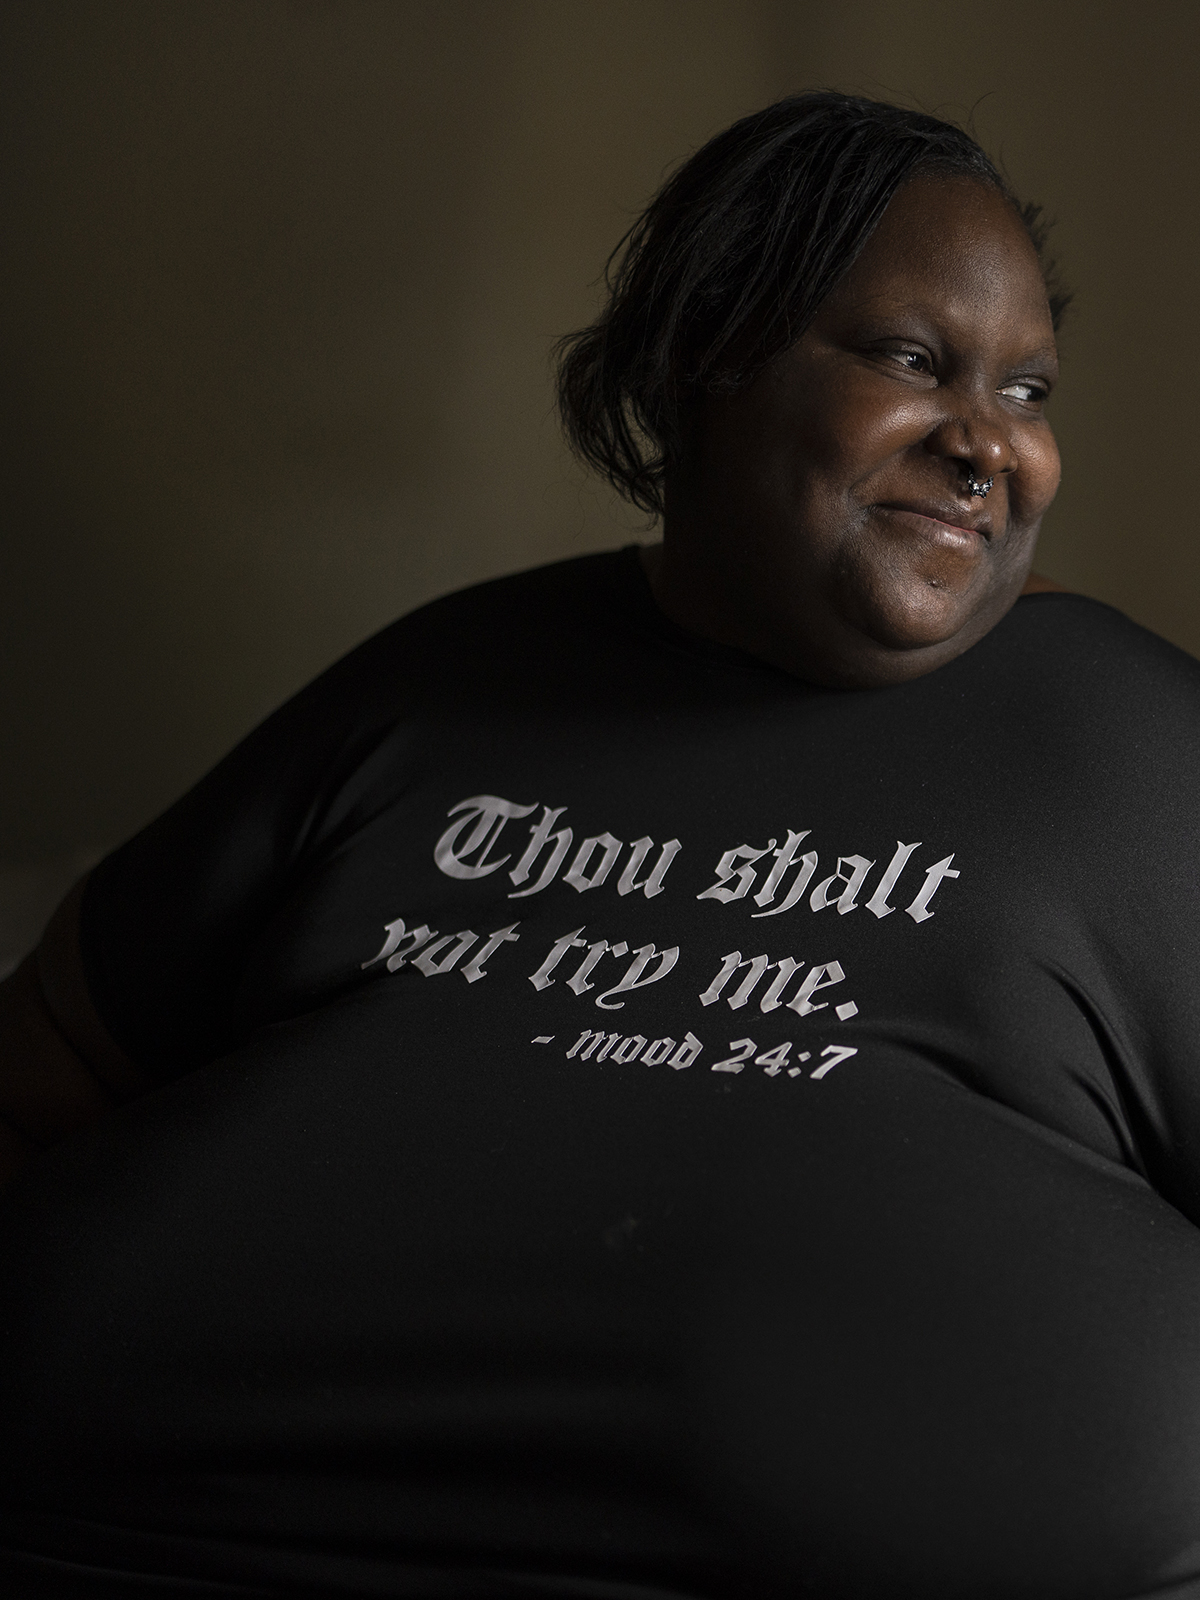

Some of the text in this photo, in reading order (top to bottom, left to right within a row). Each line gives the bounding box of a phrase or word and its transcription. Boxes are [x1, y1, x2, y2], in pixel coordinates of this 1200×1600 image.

[433, 794, 962, 925] Thou shalt
[360, 916, 859, 1022] not try me.
[565, 1029, 704, 1071] mood
[710, 1037, 859, 1080] 24:7
